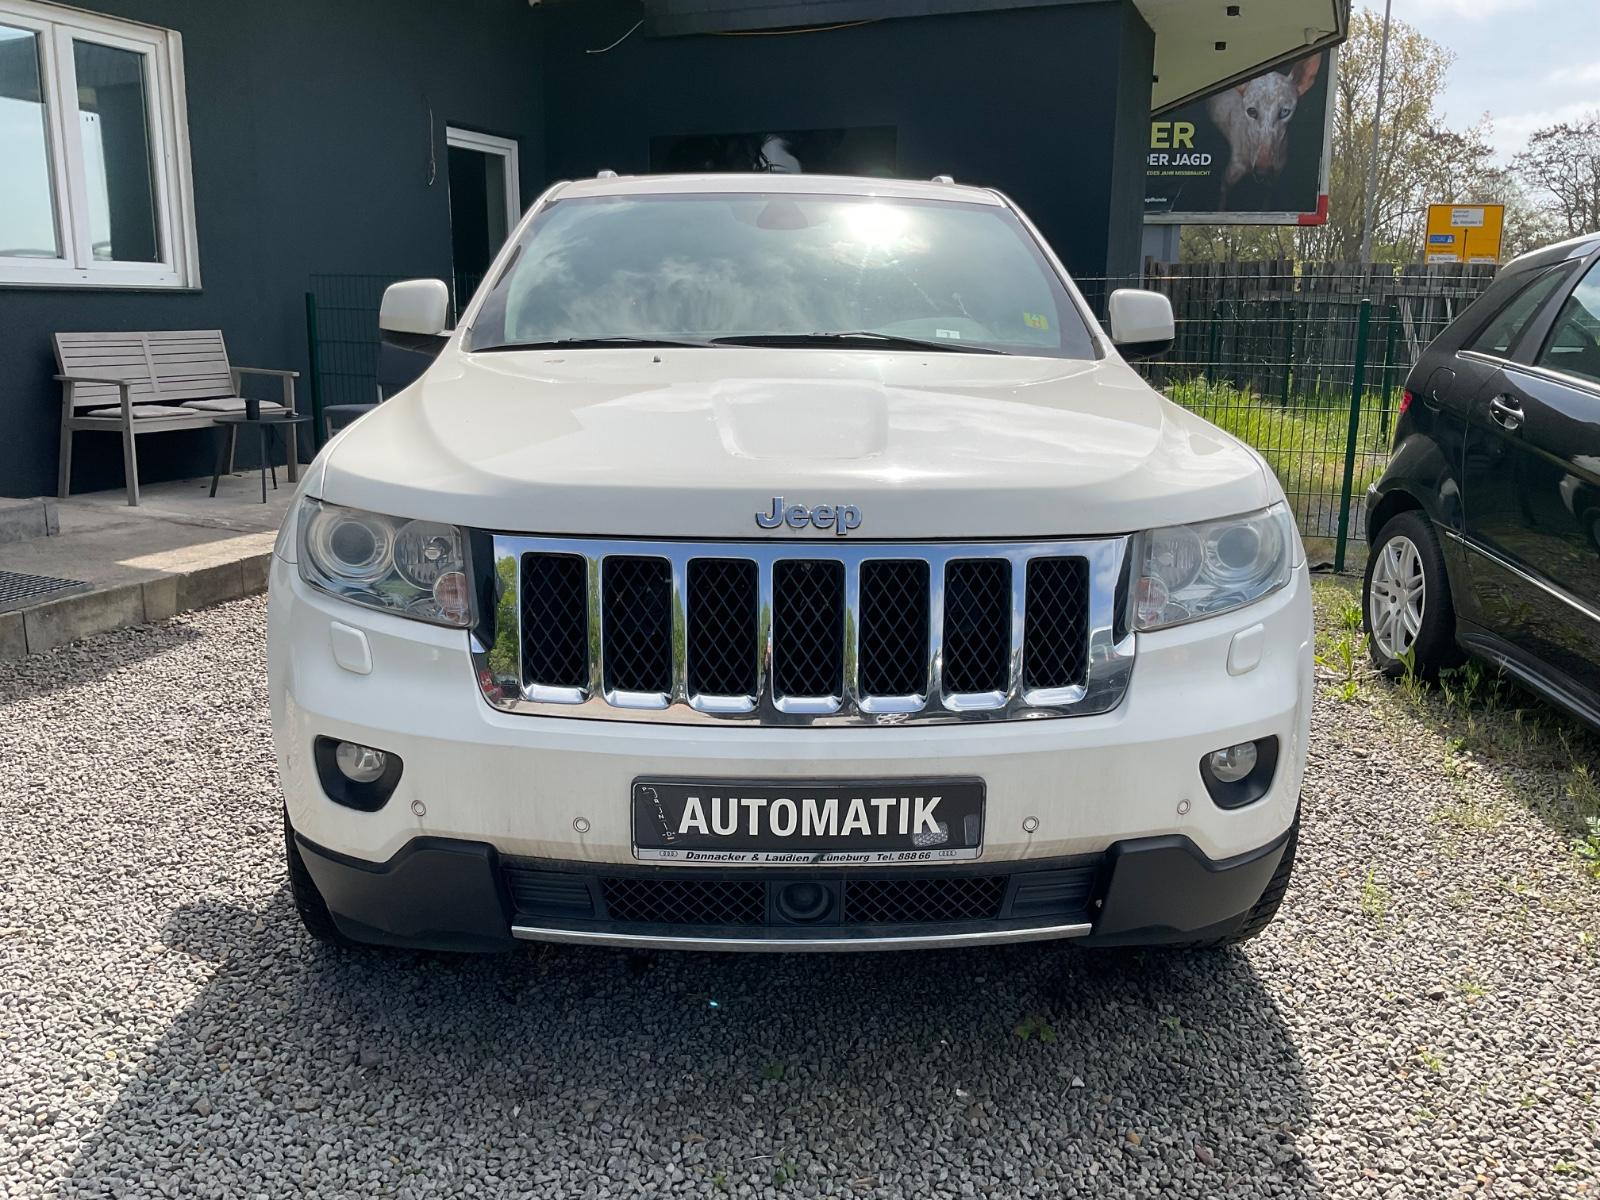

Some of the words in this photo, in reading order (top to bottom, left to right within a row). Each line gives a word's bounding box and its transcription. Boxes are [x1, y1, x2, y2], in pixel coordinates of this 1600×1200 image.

[1147, 154, 1168, 165] ER
[1172, 154, 1211, 165] JAGD
[756, 496, 862, 536] Jeep
[678, 796, 942, 837] AUTOMATIK
[686, 852, 747, 862] Dannacker
[751, 853, 760, 862] &
[765, 853, 810, 862] Laudien
[876, 852, 895, 861] Tel.
